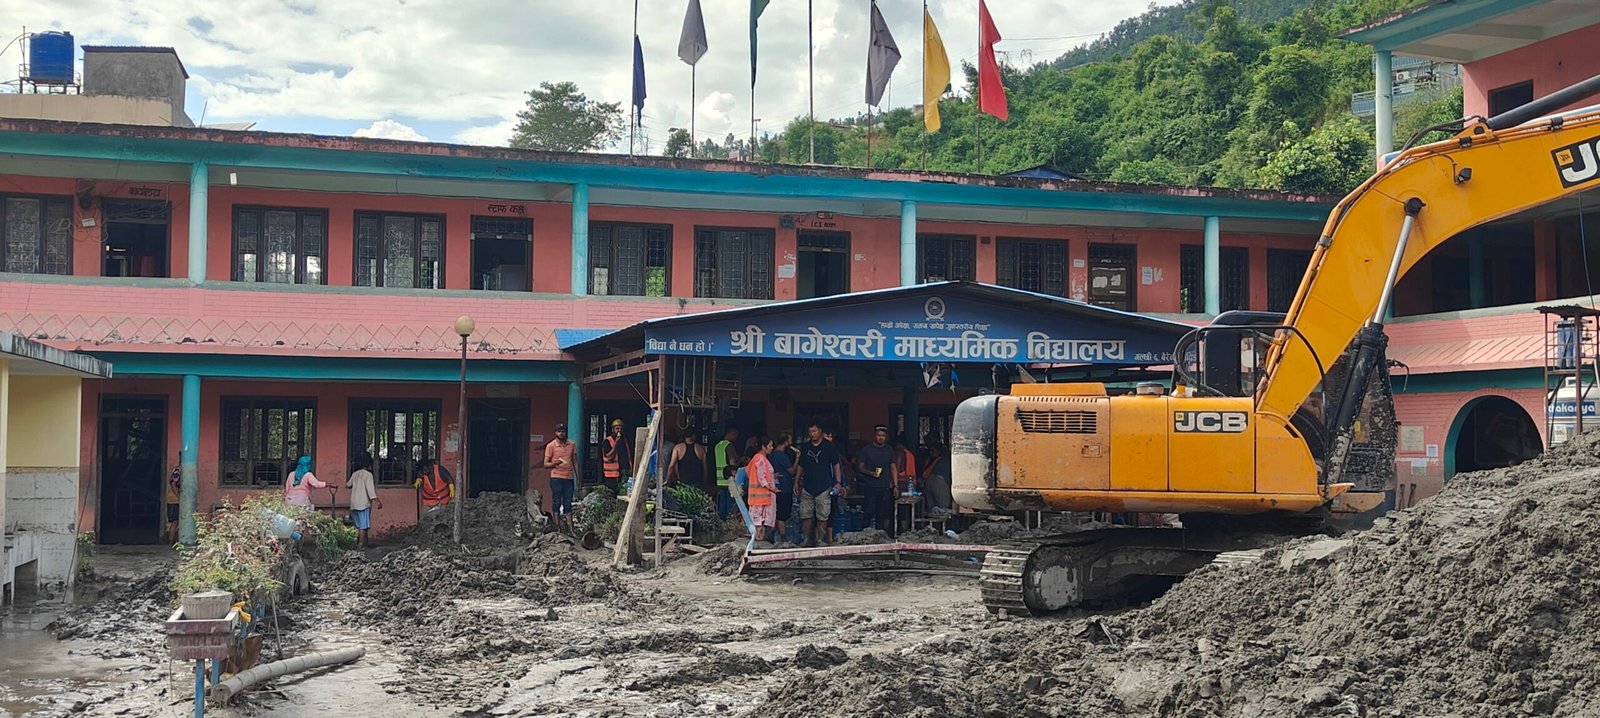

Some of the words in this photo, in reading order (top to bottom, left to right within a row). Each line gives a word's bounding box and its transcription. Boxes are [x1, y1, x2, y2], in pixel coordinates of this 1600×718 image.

[1560, 139, 1600, 183] J
[730, 324, 766, 354] श्री
[774, 326, 886, 358] बागेश्वरी
[894, 330, 1019, 359] माध्यमिक
[1027, 331, 1126, 361] विद्यालय
[1175, 412, 1247, 432] JCB
